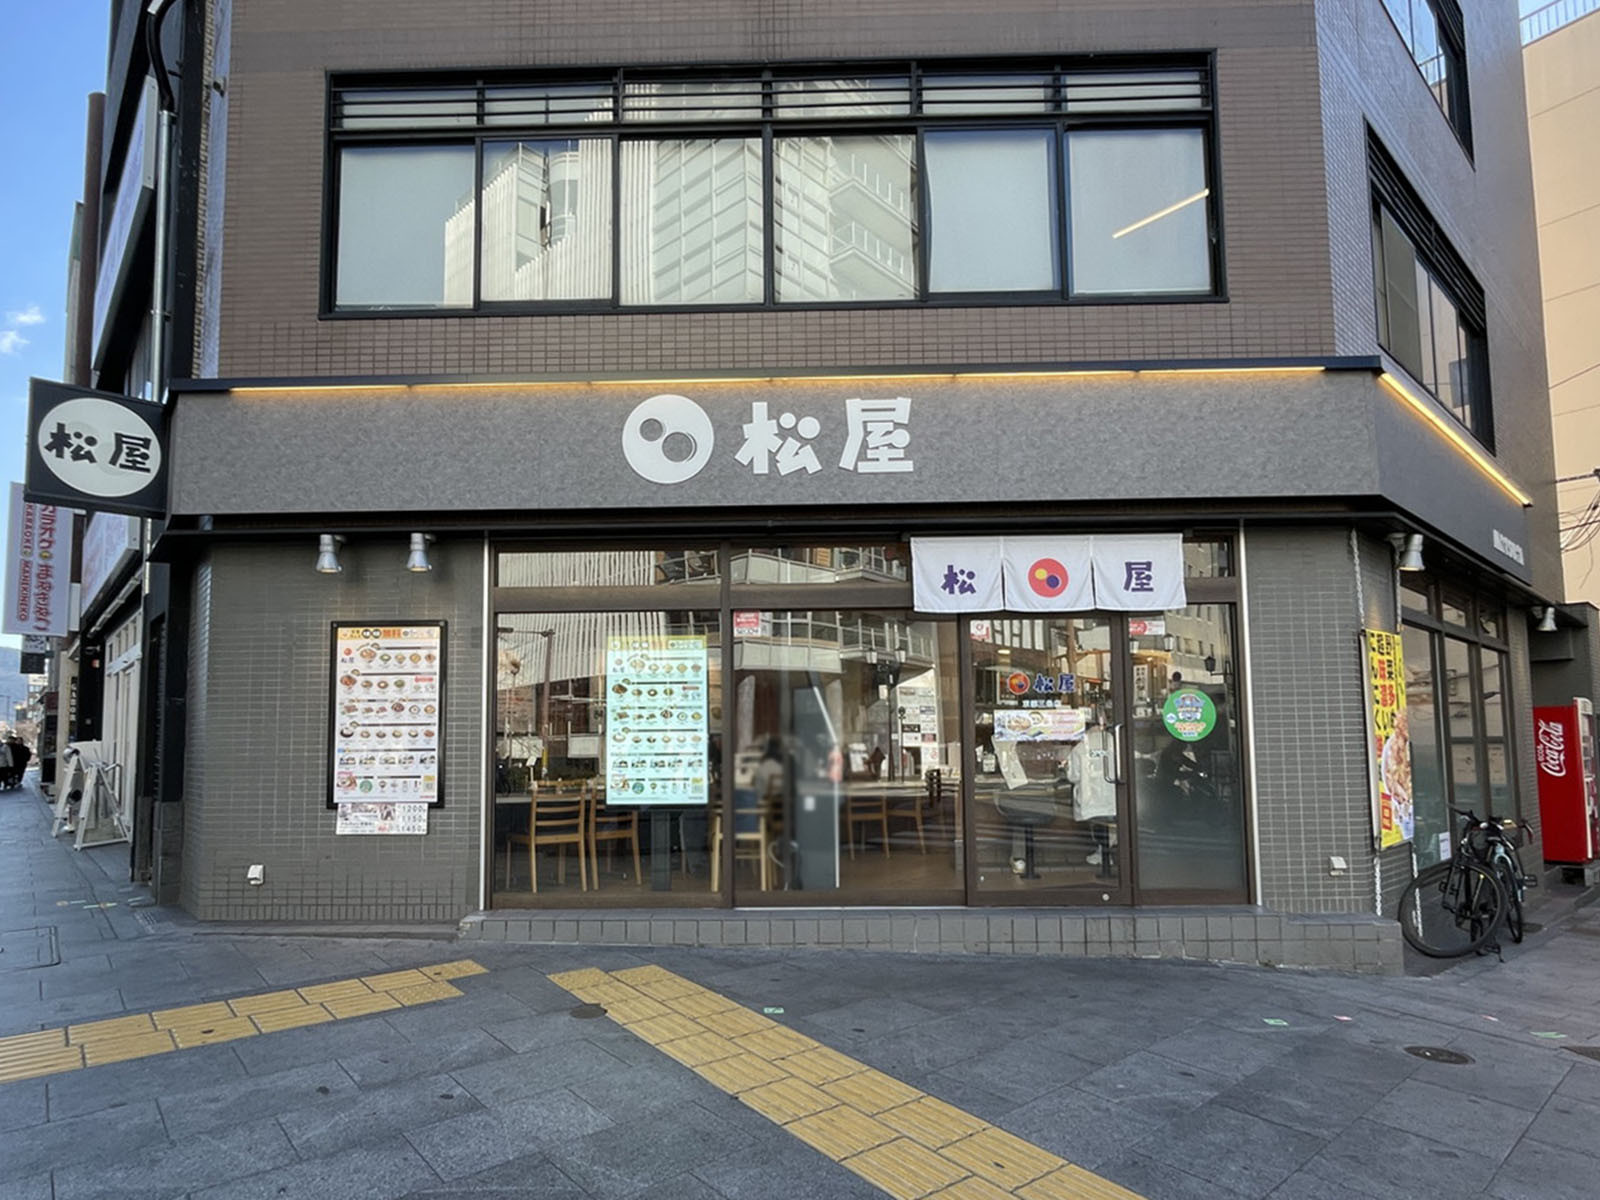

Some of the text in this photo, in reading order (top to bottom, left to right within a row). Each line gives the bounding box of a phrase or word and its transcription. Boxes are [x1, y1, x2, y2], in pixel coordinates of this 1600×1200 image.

[43, 421, 152, 474] 松屋
[734, 397, 914, 476] 松屋
[1033, 672, 1076, 693] 松屋
